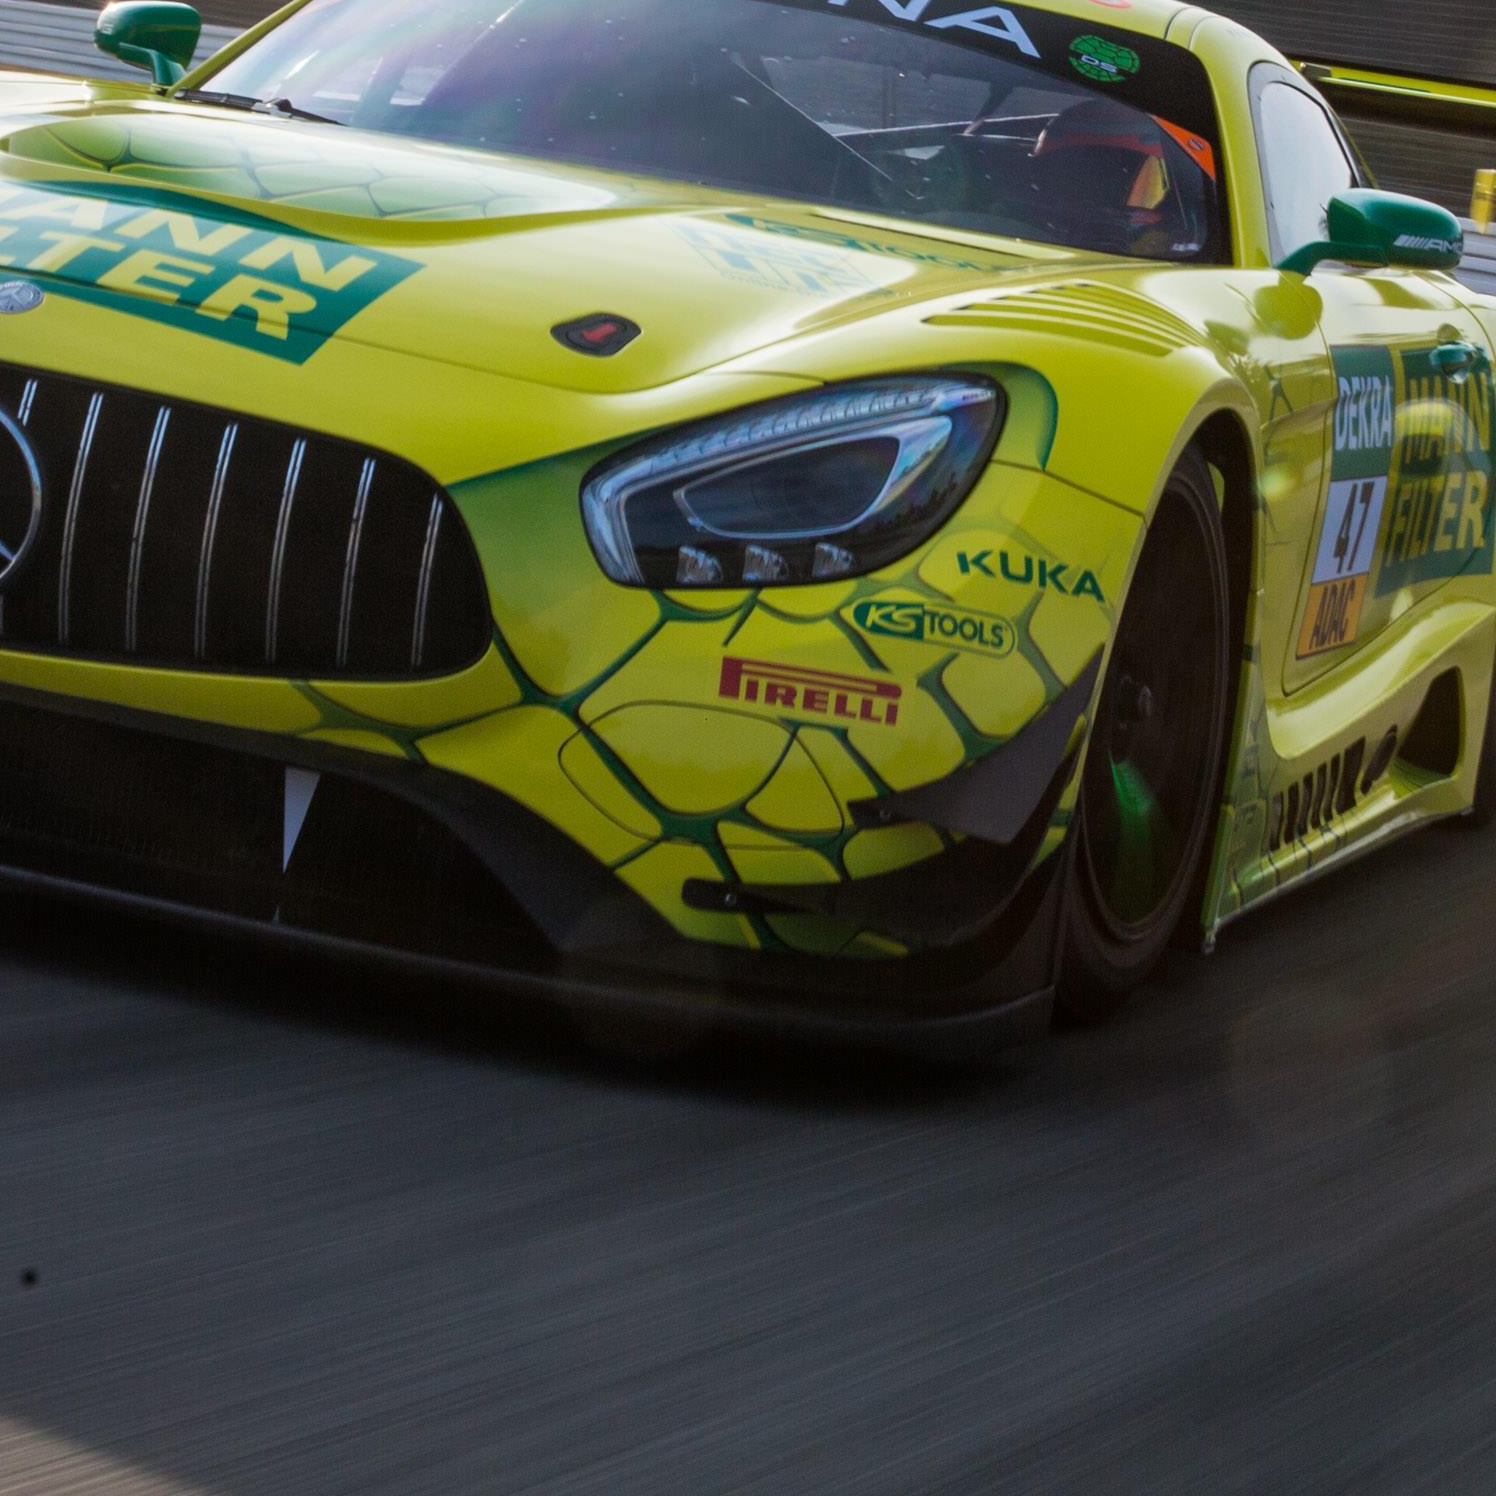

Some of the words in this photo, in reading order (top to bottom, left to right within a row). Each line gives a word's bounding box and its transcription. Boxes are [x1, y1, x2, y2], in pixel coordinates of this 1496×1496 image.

[1081, 54, 1119, 74] DS
[1334, 374, 1393, 451] DEKRA
[1405, 371, 1491, 465] MANN
[1333, 480, 1375, 574] 47
[1385, 470, 1488, 568] FILTER
[957, 549, 1105, 603] KUKA
[866, 602, 925, 635] KS
[925, 609, 1007, 649] TOOLS
[1309, 579, 1355, 650] ADAC
[718, 655, 903, 727] PIRELLI
